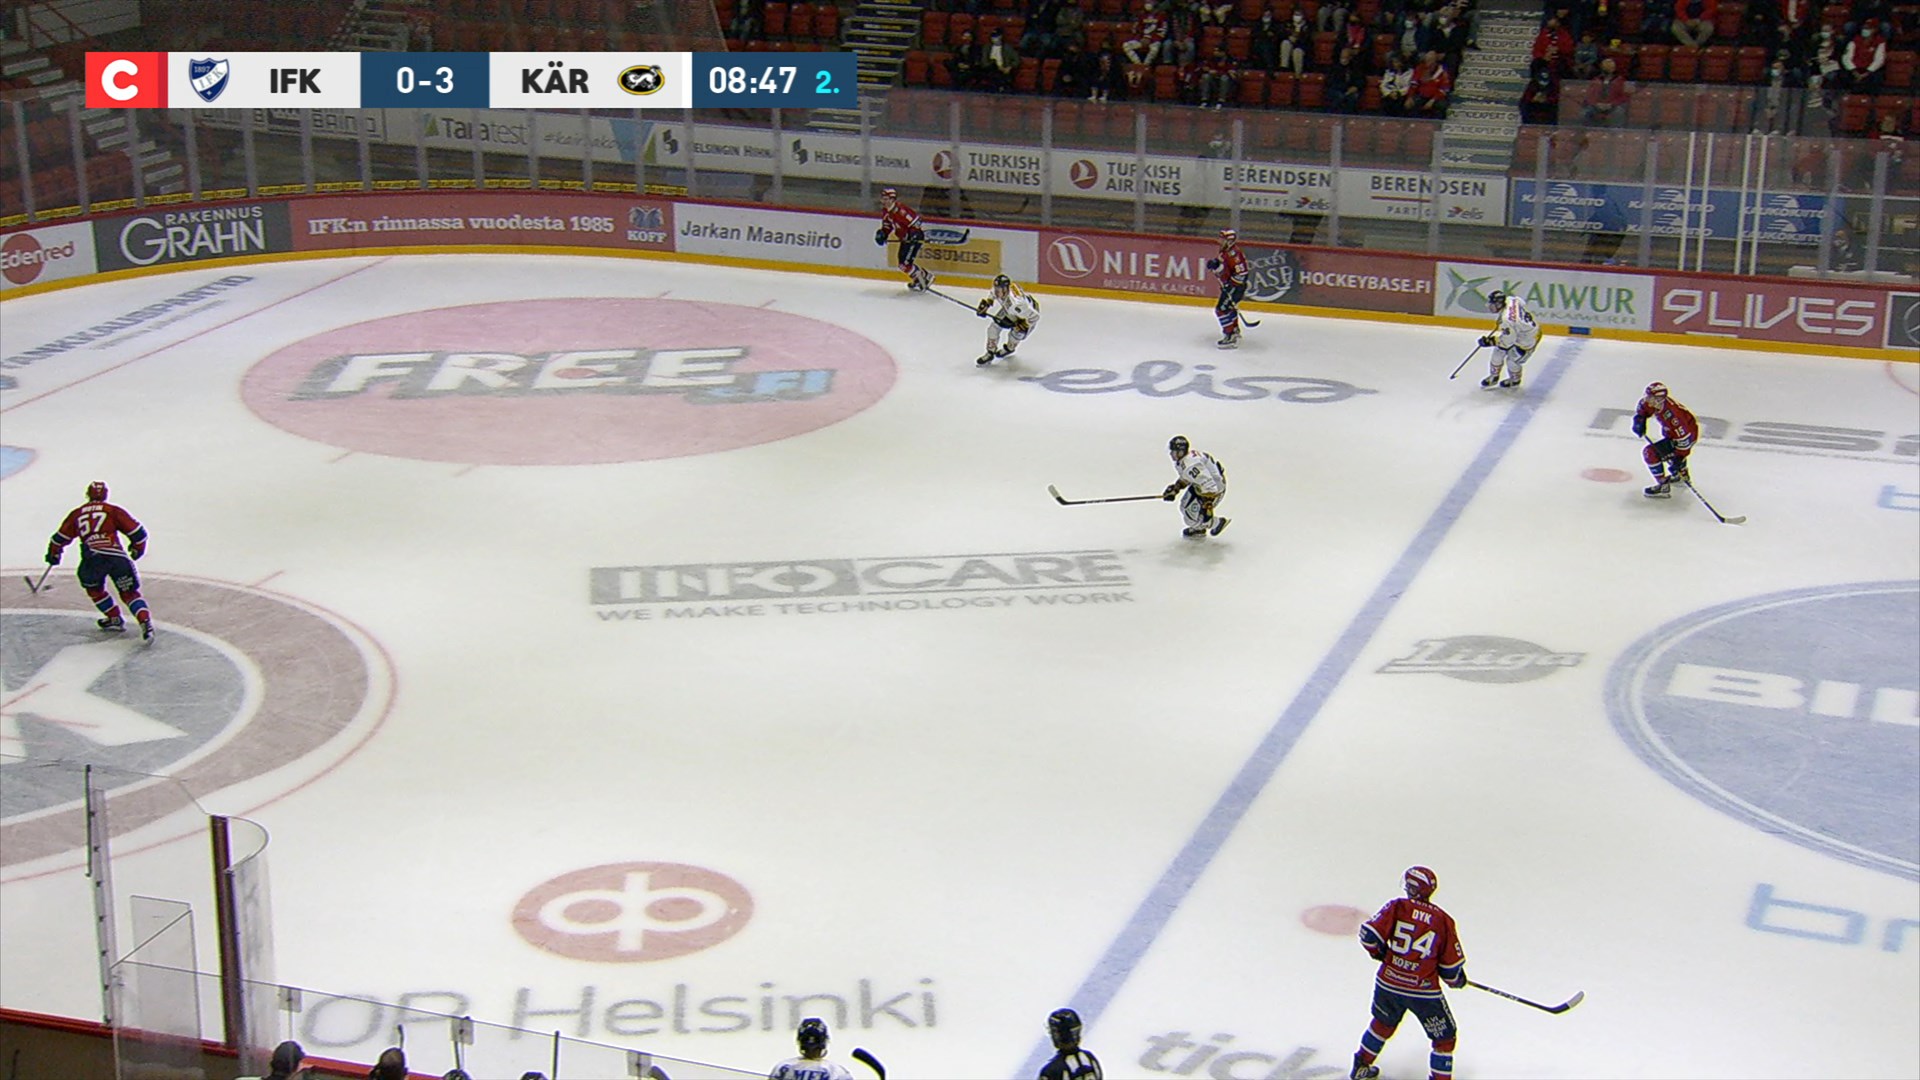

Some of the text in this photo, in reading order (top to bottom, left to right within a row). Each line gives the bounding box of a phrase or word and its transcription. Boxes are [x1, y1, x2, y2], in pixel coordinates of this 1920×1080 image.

[815, 150, 861, 166] HELSING
[968, 152, 1040, 171] TURKISH
[967, 168, 1041, 186] AIRLINES
[1105, 178, 1181, 196] AIRINES
[1223, 166, 1331, 187] BERENDSEN
[165, 206, 263, 226] RAKENNUS
[308, 215, 615, 235] IFK:n rinnassa vuodesta 1985
[120, 217, 265, 265] GRAHN
[627, 230, 668, 244] KOFF
[680, 221, 842, 250] Jarkan Maansiirto
[1, 241, 75, 270] Edenred
[918, 246, 990, 265] ISSUMIES
[1103, 250, 1206, 281] NIEMI
[1299, 270, 1431, 294] HOCKEYBASE.FI
[1662, 288, 1876, 337] 9LIVES
[1020, 359, 1379, 405] elisa
[1188, 467, 1200, 479] 20
[78, 512, 107, 536] 57
[597, 591, 1135, 621] WE MAKE TECHNOLOGY WORK
[1411, 908, 1432, 924] DYK
[1391, 919, 1436, 960] 54
[1391, 955, 1420, 971] KOFF
[508, 978, 938, 1041] Helsinki
